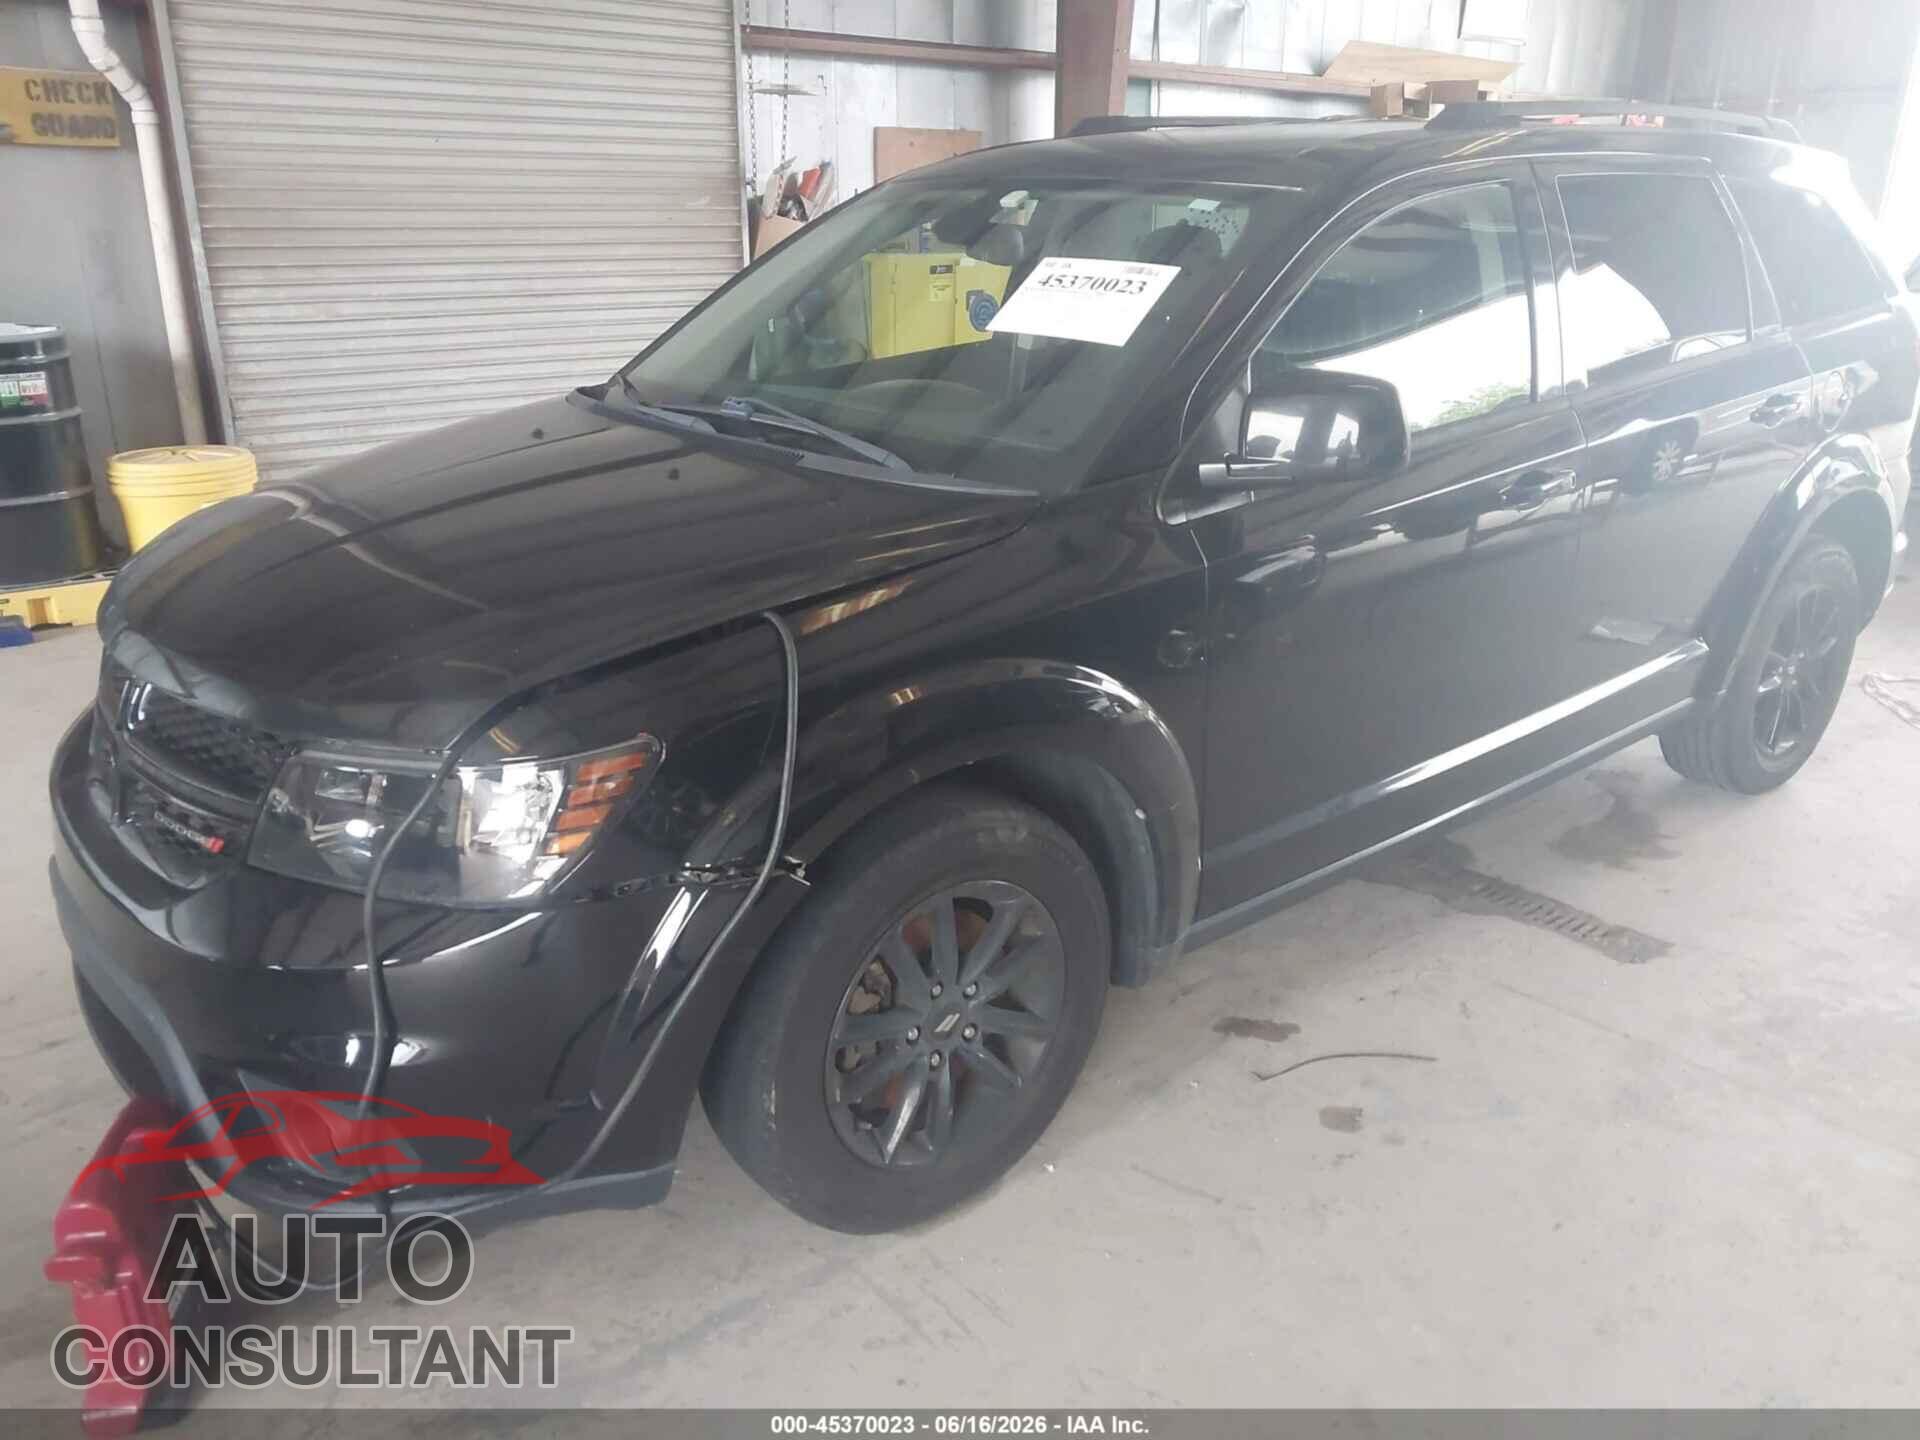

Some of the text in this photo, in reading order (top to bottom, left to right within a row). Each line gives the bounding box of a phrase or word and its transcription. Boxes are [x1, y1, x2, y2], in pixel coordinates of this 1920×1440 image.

[24, 78, 112, 105] CHECK
[30, 111, 117, 139] GUARD
[1038, 273, 1147, 295] 45370023
